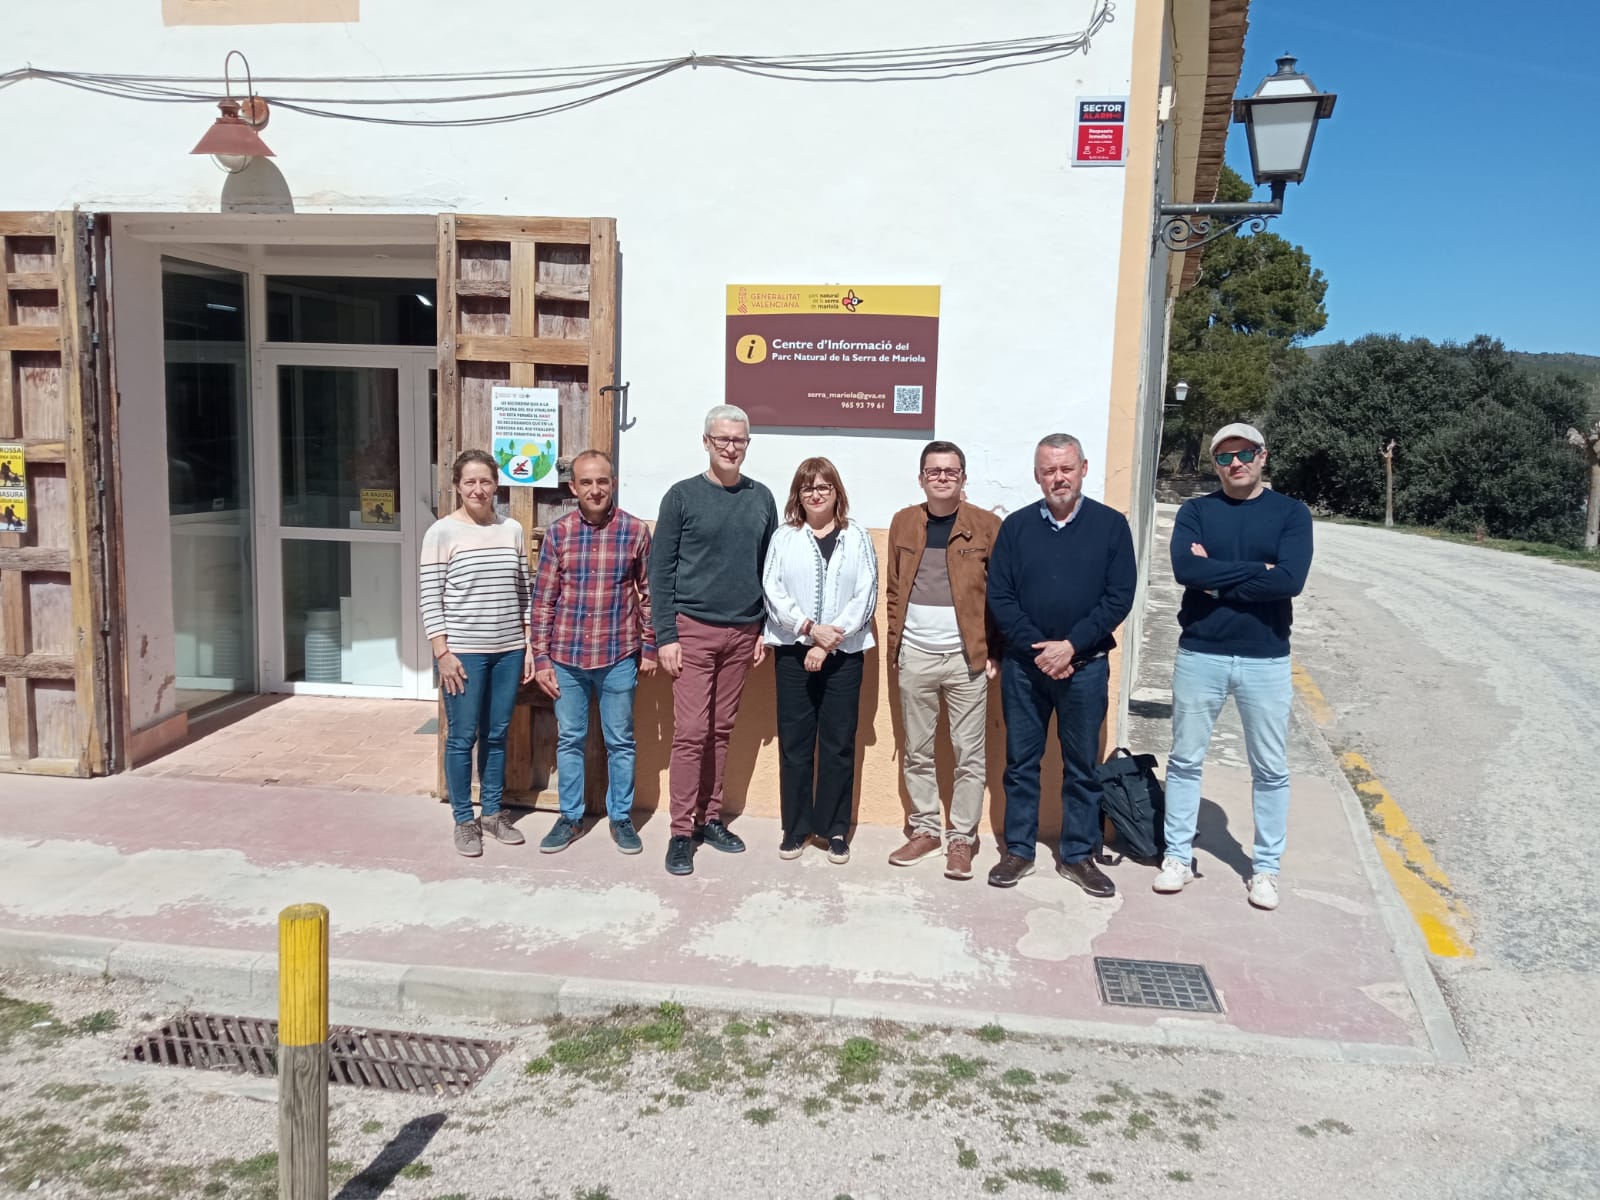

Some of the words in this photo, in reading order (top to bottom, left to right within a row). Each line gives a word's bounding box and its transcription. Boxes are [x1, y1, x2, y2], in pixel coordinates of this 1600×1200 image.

[1083, 104, 1121, 112] SECTOR
[751, 293, 800, 301] GENERALITAT
[752, 301, 800, 309] VALENCIANA
[772, 339, 813, 349] Centre
[895, 343, 909, 351] del
[772, 353, 791, 361] Parc
[794, 353, 827, 361] Natural
[842, 354, 850, 362] la
[852, 354, 876, 362] Serra
[878, 354, 890, 362] de
[892, 355, 926, 363] Mariola
[807, 391, 886, 400] serra_mariola@gva.es
